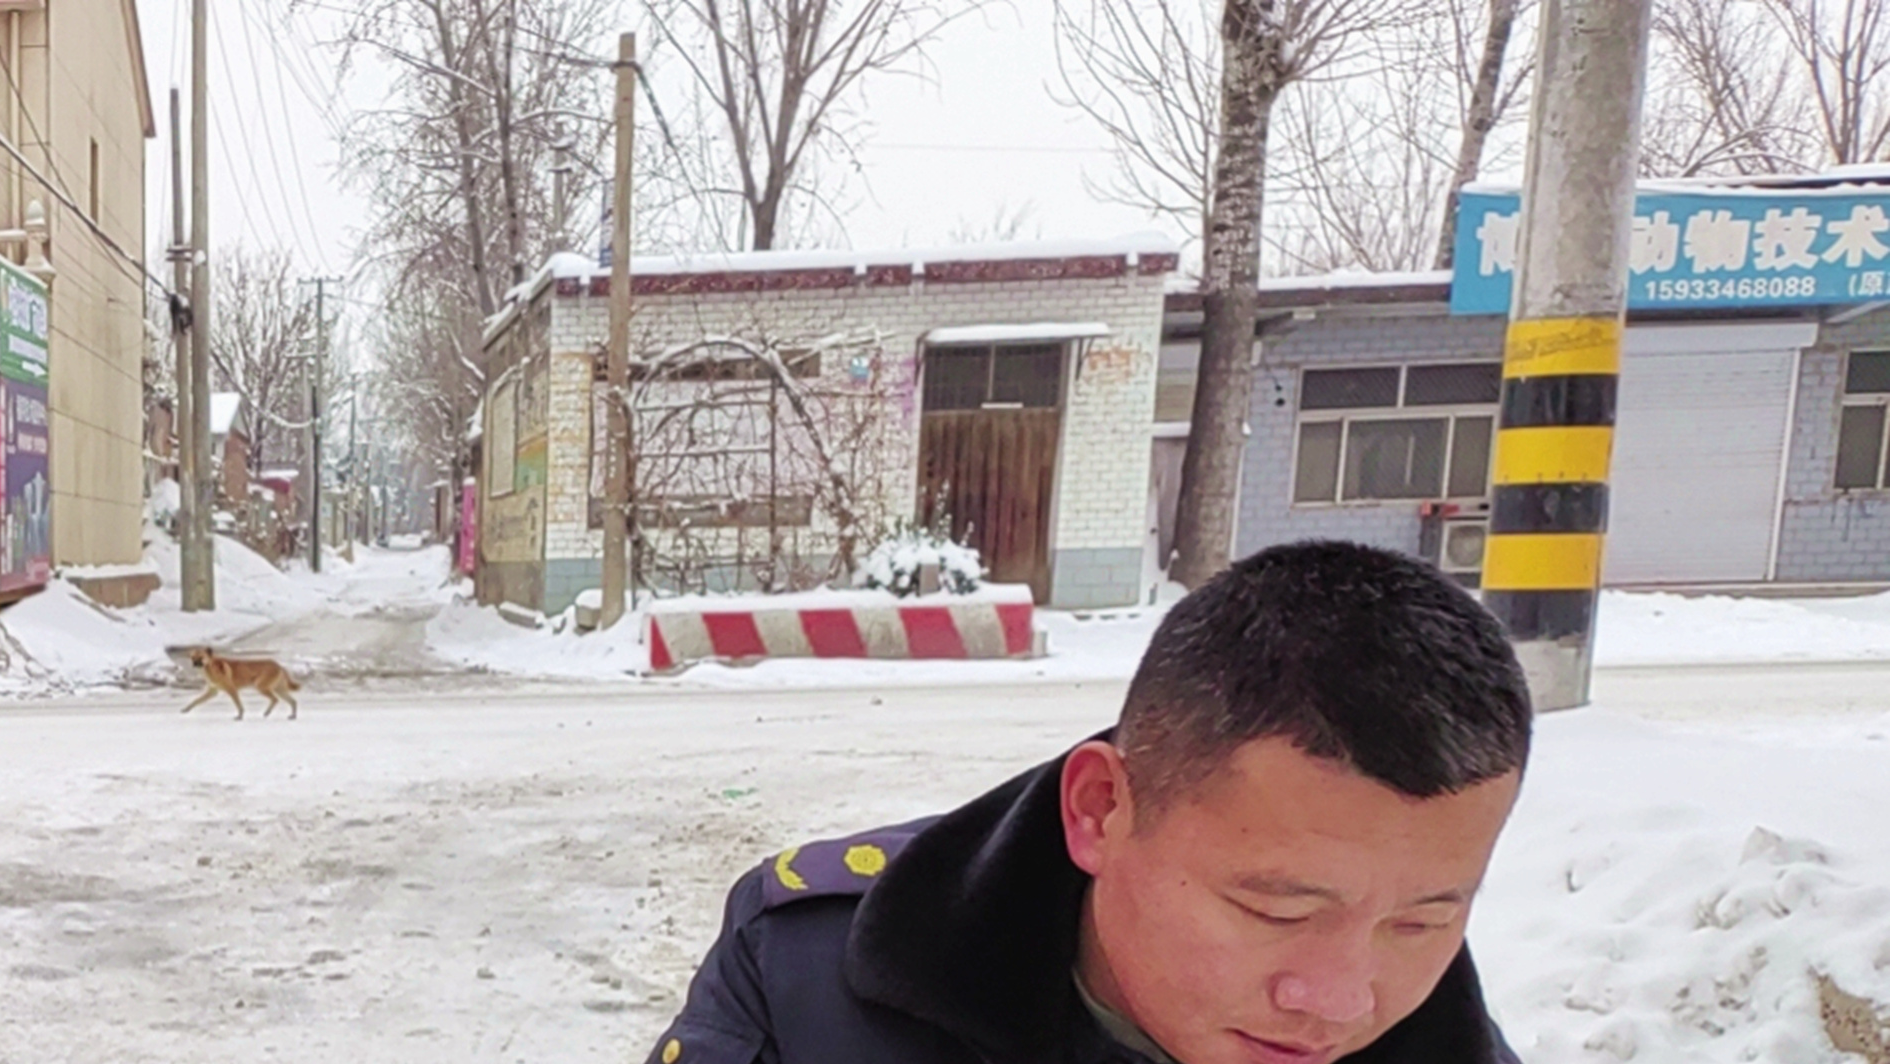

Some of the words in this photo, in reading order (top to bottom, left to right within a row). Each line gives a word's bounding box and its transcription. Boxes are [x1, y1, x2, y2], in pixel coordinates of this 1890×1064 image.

[1476, 204, 1890, 276] 博动物技术
[1645, 276, 1816, 300] 15933468088
[1848, 269, 1890, 297] (原
